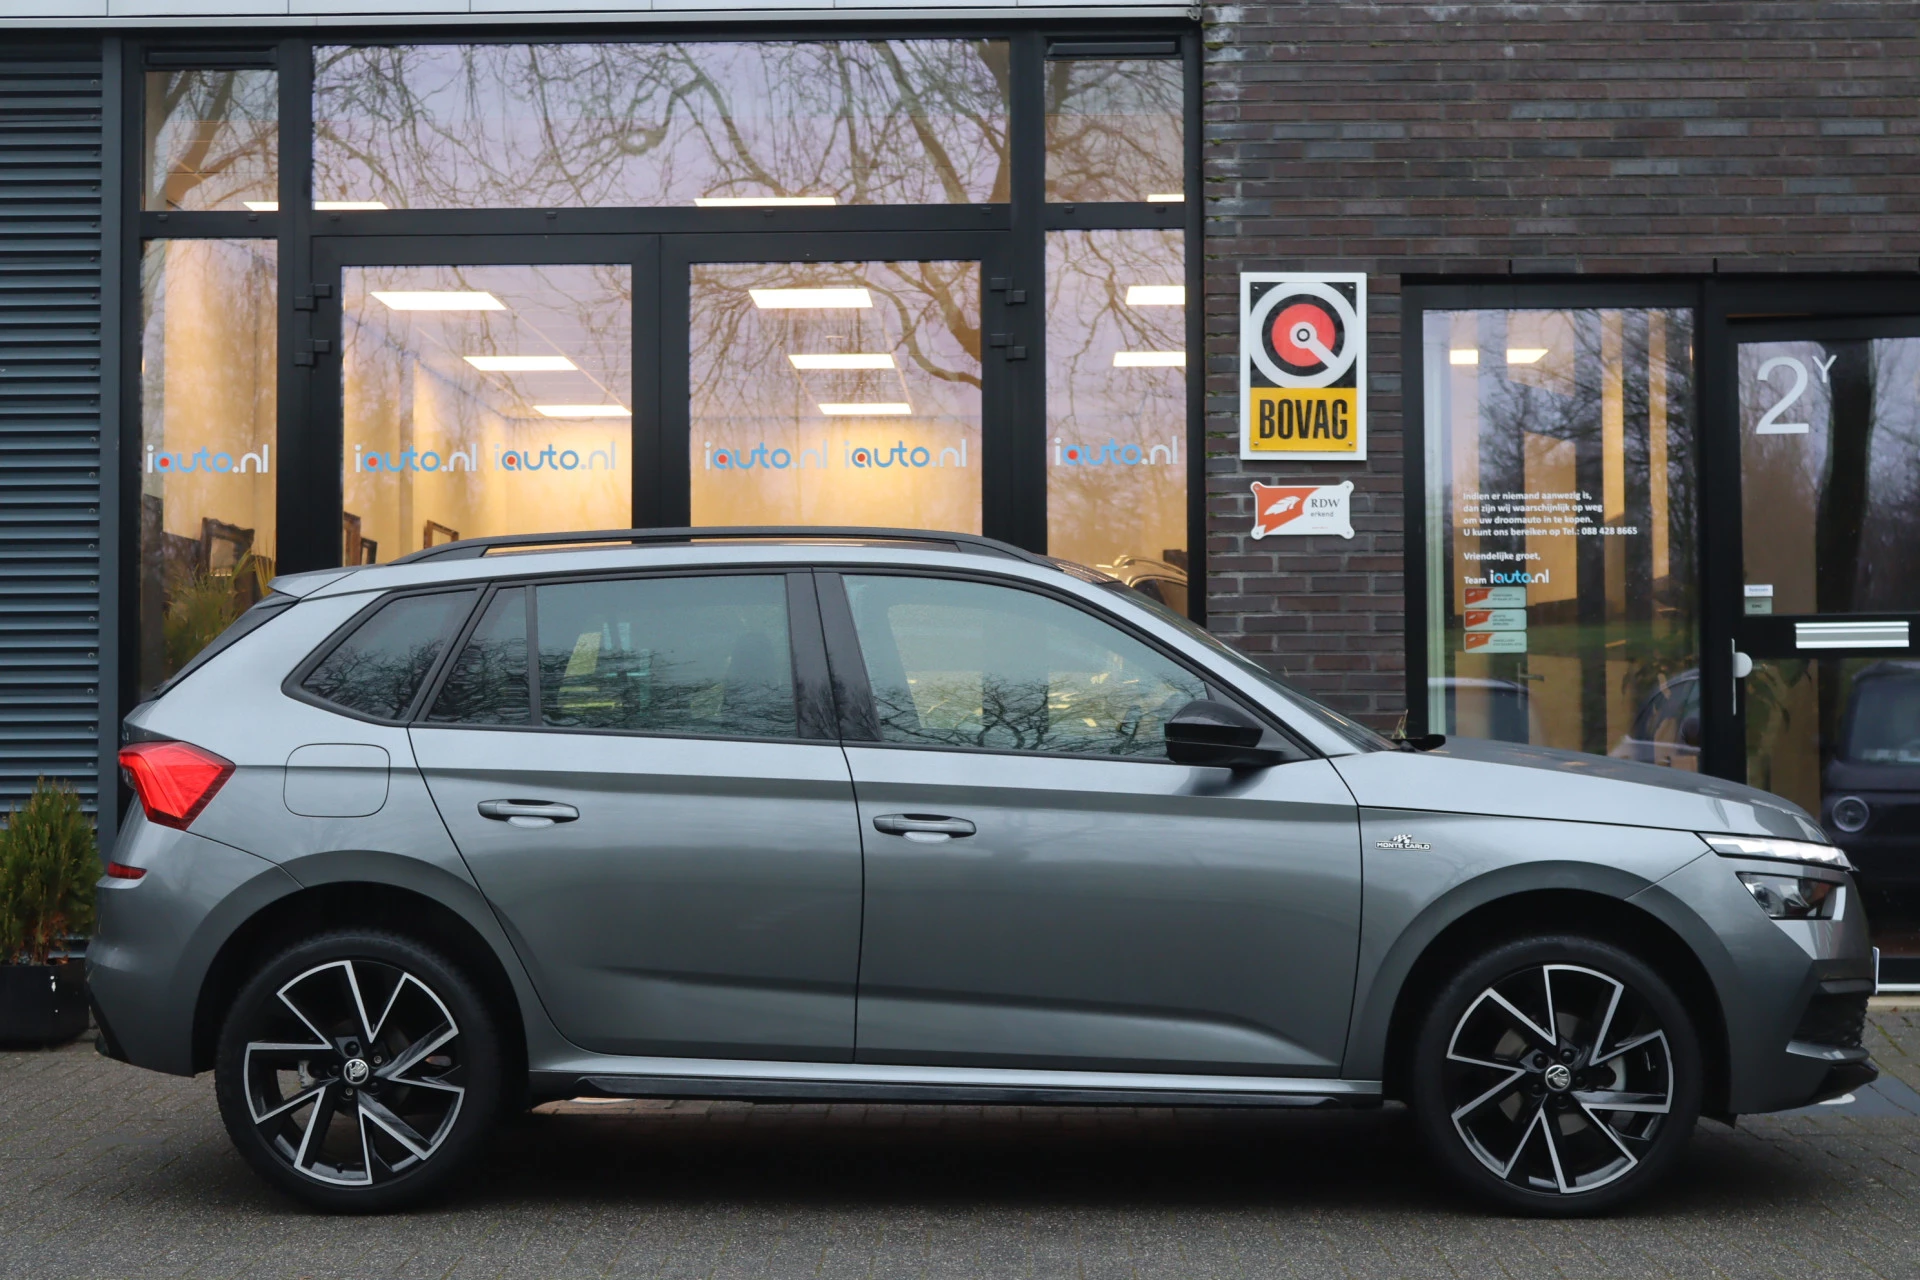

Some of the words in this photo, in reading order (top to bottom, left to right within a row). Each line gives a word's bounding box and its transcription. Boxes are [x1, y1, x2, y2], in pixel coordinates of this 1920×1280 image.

[1259, 398, 1348, 440] BOVAG
[146, 443, 269, 474] iauto.nl
[354, 443, 477, 473] iauto.nl
[494, 441, 616, 472] iauto.nl
[704, 440, 828, 470] iauto.nl
[843, 438, 967, 468] iauto.nl
[1053, 436, 1178, 466] iauto.nl
[1311, 498, 1340, 508] RDW
[1463, 492, 1490, 500] Indien
[1502, 492, 1540, 500] niemand
[1541, 492, 1581, 500] aanwezig
[1582, 491, 1592, 500] is,
[1463, 504, 1479, 512] dan
[1481, 504, 1496, 513] zijn
[1497, 504, 1511, 513] wij
[1512, 503, 1570, 513] waarschijnlijk
[1584, 504, 1603, 512] weg
[1494, 516, 1542, 524] droomauto
[1564, 516, 1593, 524] kopen.
[1472, 528, 1492, 536] kunt
[1510, 528, 1548, 536] bereiken
[1549, 529, 1561, 537] op
[1581, 527, 1598, 535] 088
[1598, 527, 1615, 535] 428
[1616, 526, 1638, 535] 8665
[1463, 552, 1515, 561] Vriendelijke
[1515, 552, 1541, 561] groet,
[1464, 576, 1487, 584] Team
[1489, 569, 1550, 584] iauto.nl
